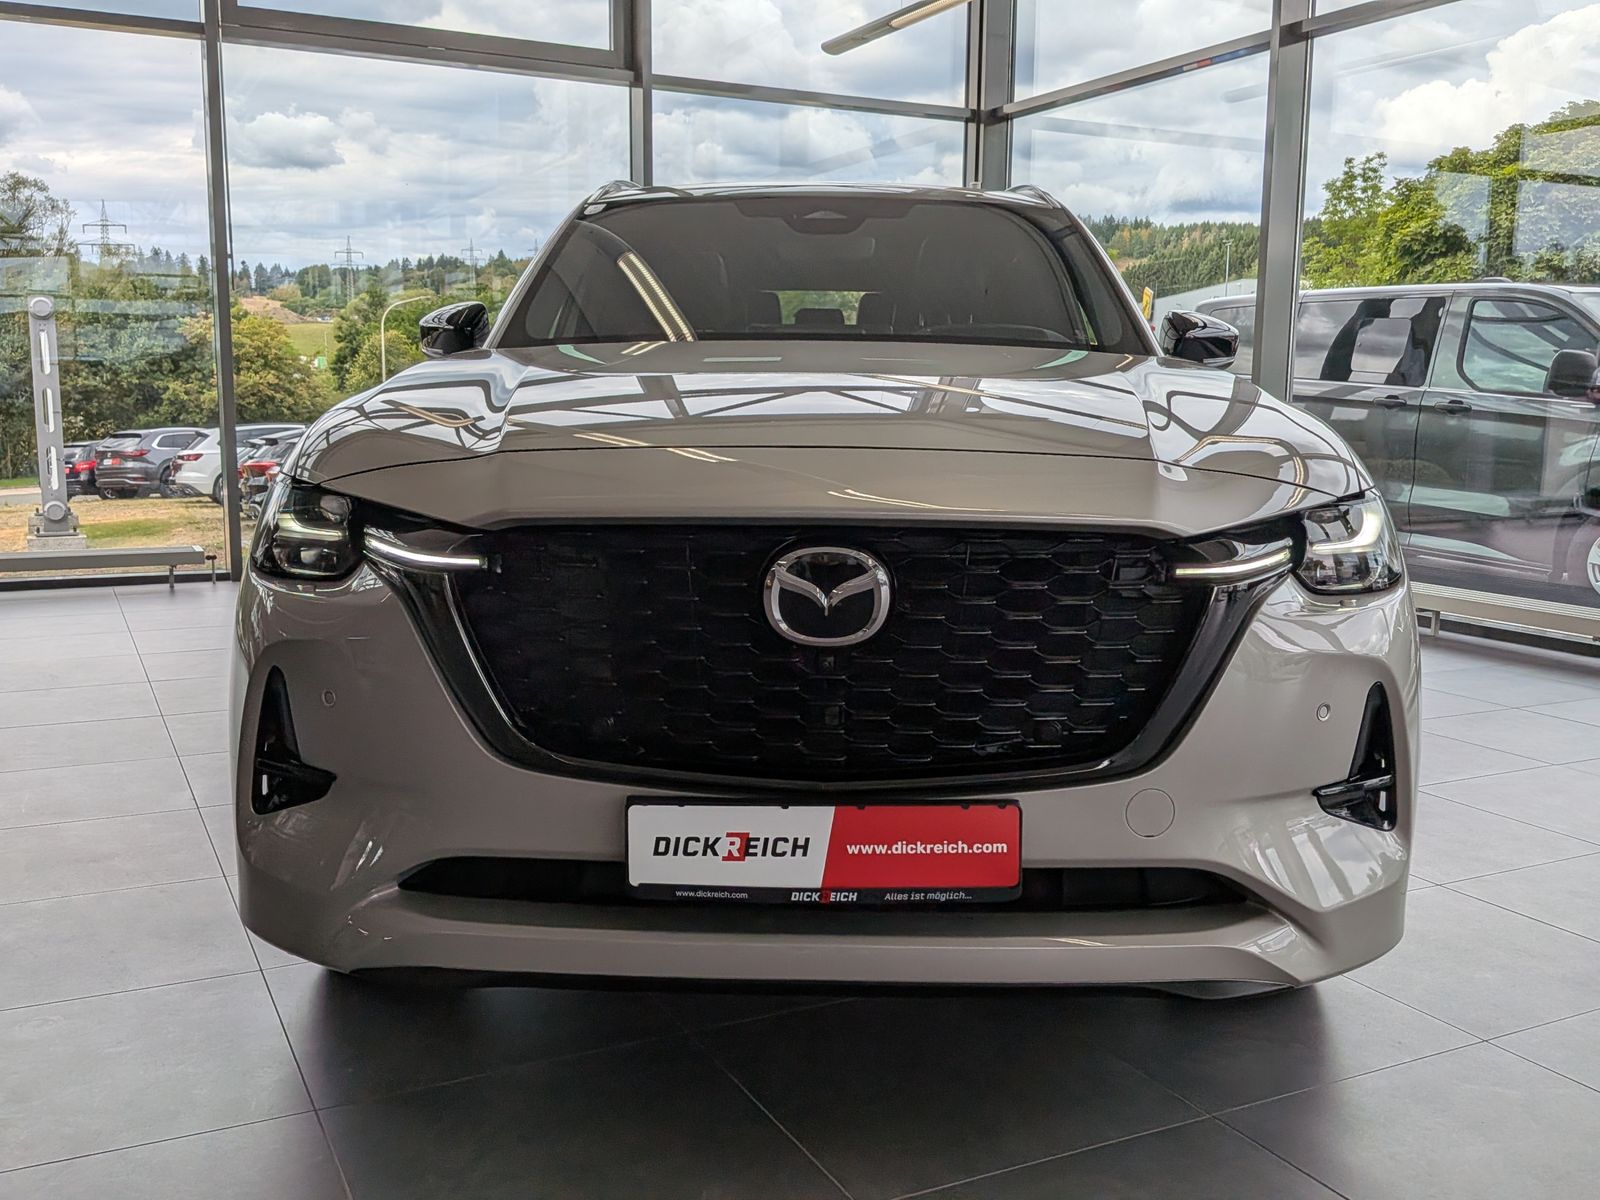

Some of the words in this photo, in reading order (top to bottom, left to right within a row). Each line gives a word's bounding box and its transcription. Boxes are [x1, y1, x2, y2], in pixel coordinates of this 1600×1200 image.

[653, 834, 811, 859] DICKREICH
[847, 840, 1008, 855] www.dickreich.com
[676, 889, 748, 899] www.dickreich.com
[884, 892, 908, 901] Alles
[910, 892, 925, 900] ist
[927, 891, 973, 902] möglich...
